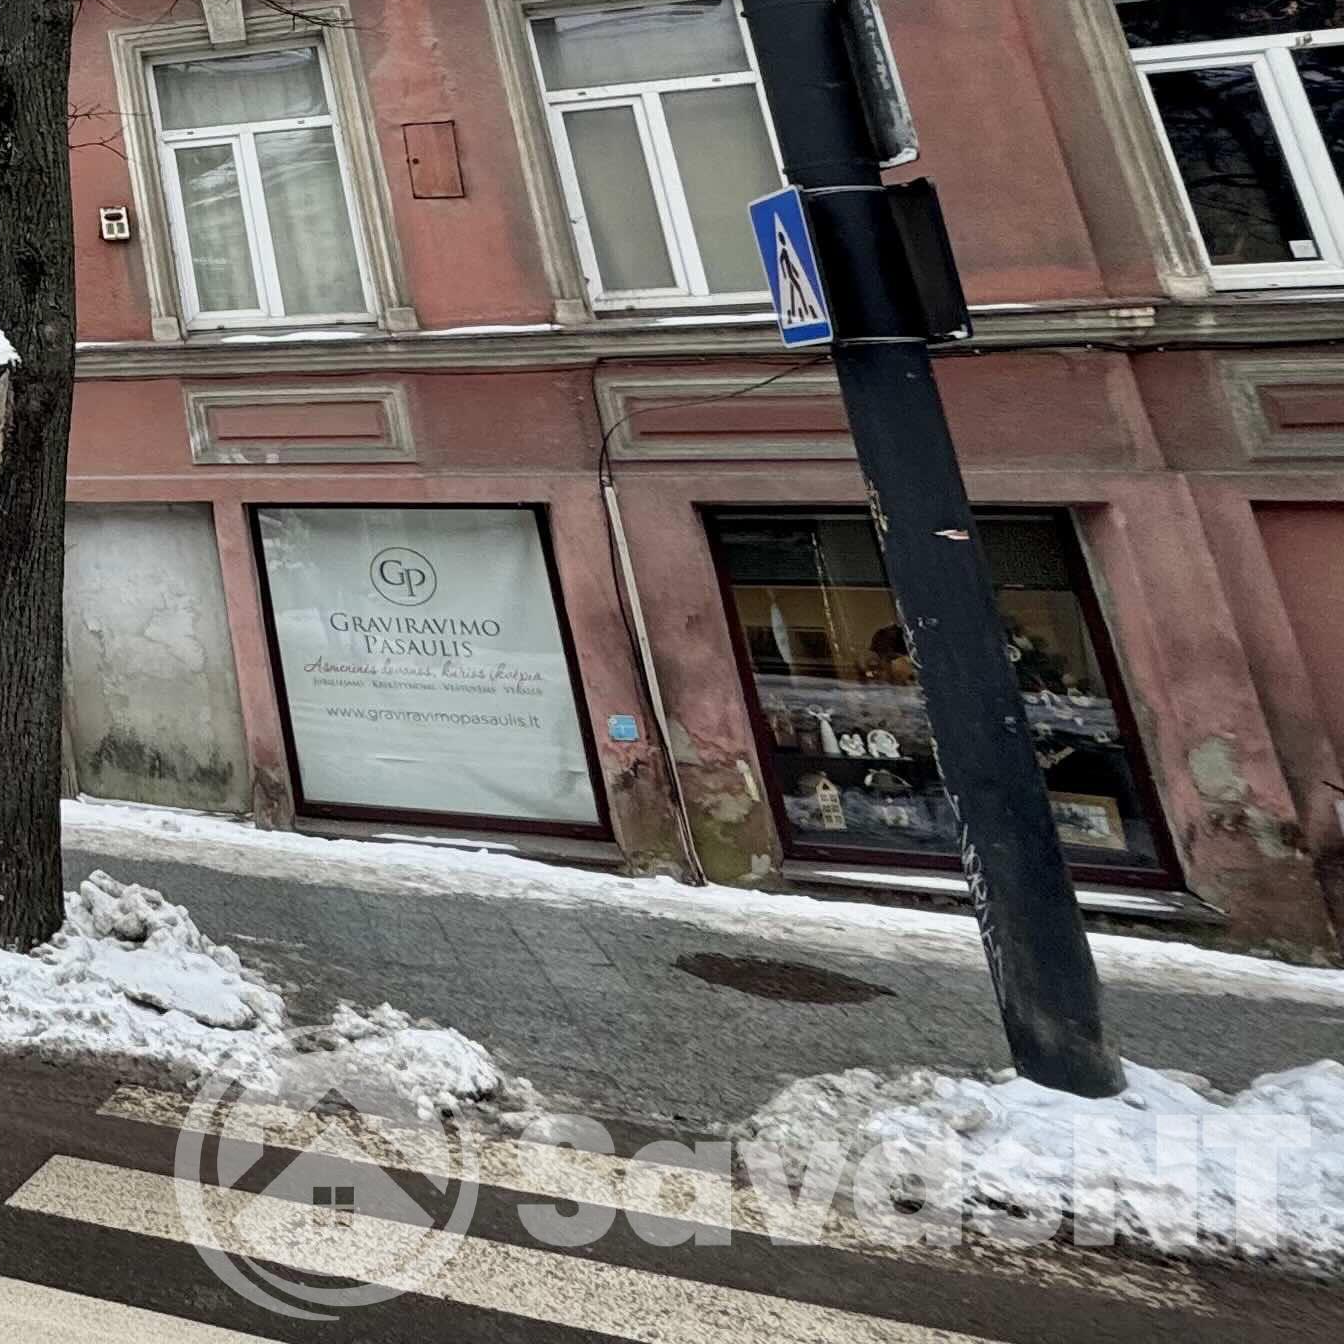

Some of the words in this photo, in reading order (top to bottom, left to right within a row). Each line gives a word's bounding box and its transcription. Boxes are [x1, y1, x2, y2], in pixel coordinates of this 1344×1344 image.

[329, 612, 501, 637] GRAVIRAVIMO
[364, 635, 473, 657] PASAULIS
[326, 706, 541, 729] www.graviravimopasaulis.lt
